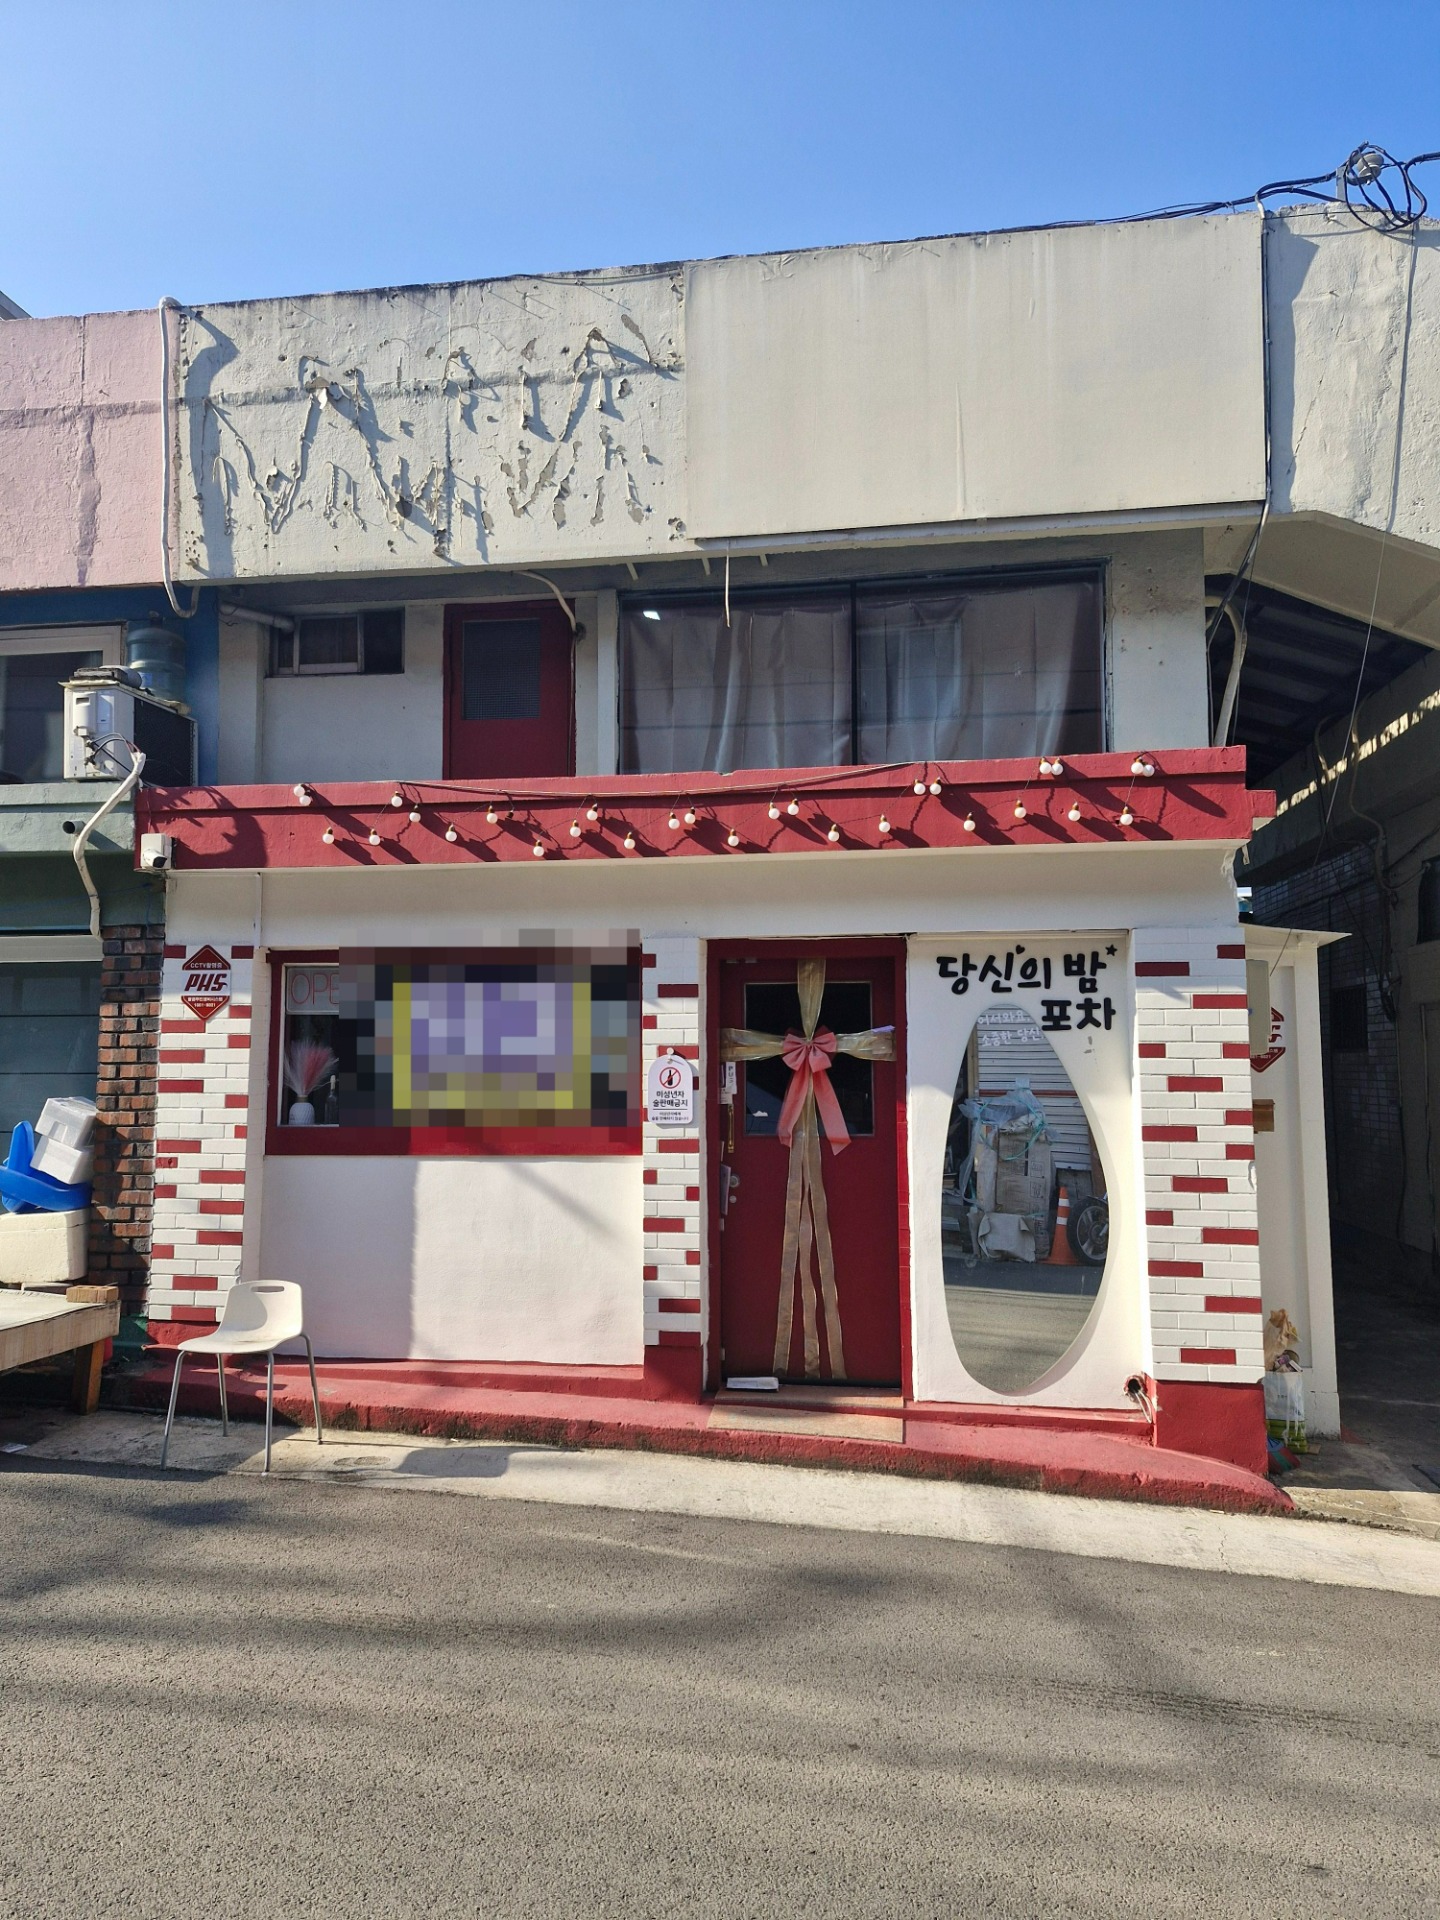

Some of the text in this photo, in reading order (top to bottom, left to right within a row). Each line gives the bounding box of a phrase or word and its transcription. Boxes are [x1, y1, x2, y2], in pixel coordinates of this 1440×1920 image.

[936, 951, 1107, 994] 당신의 밤
[184, 973, 228, 992] PHS
[1041, 997, 1116, 1031] 포차
[982, 1031, 1012, 1047] 소중한
[652, 1098, 688, 1108] 술판매금지
[656, 1090, 685, 1099] 미성년자
